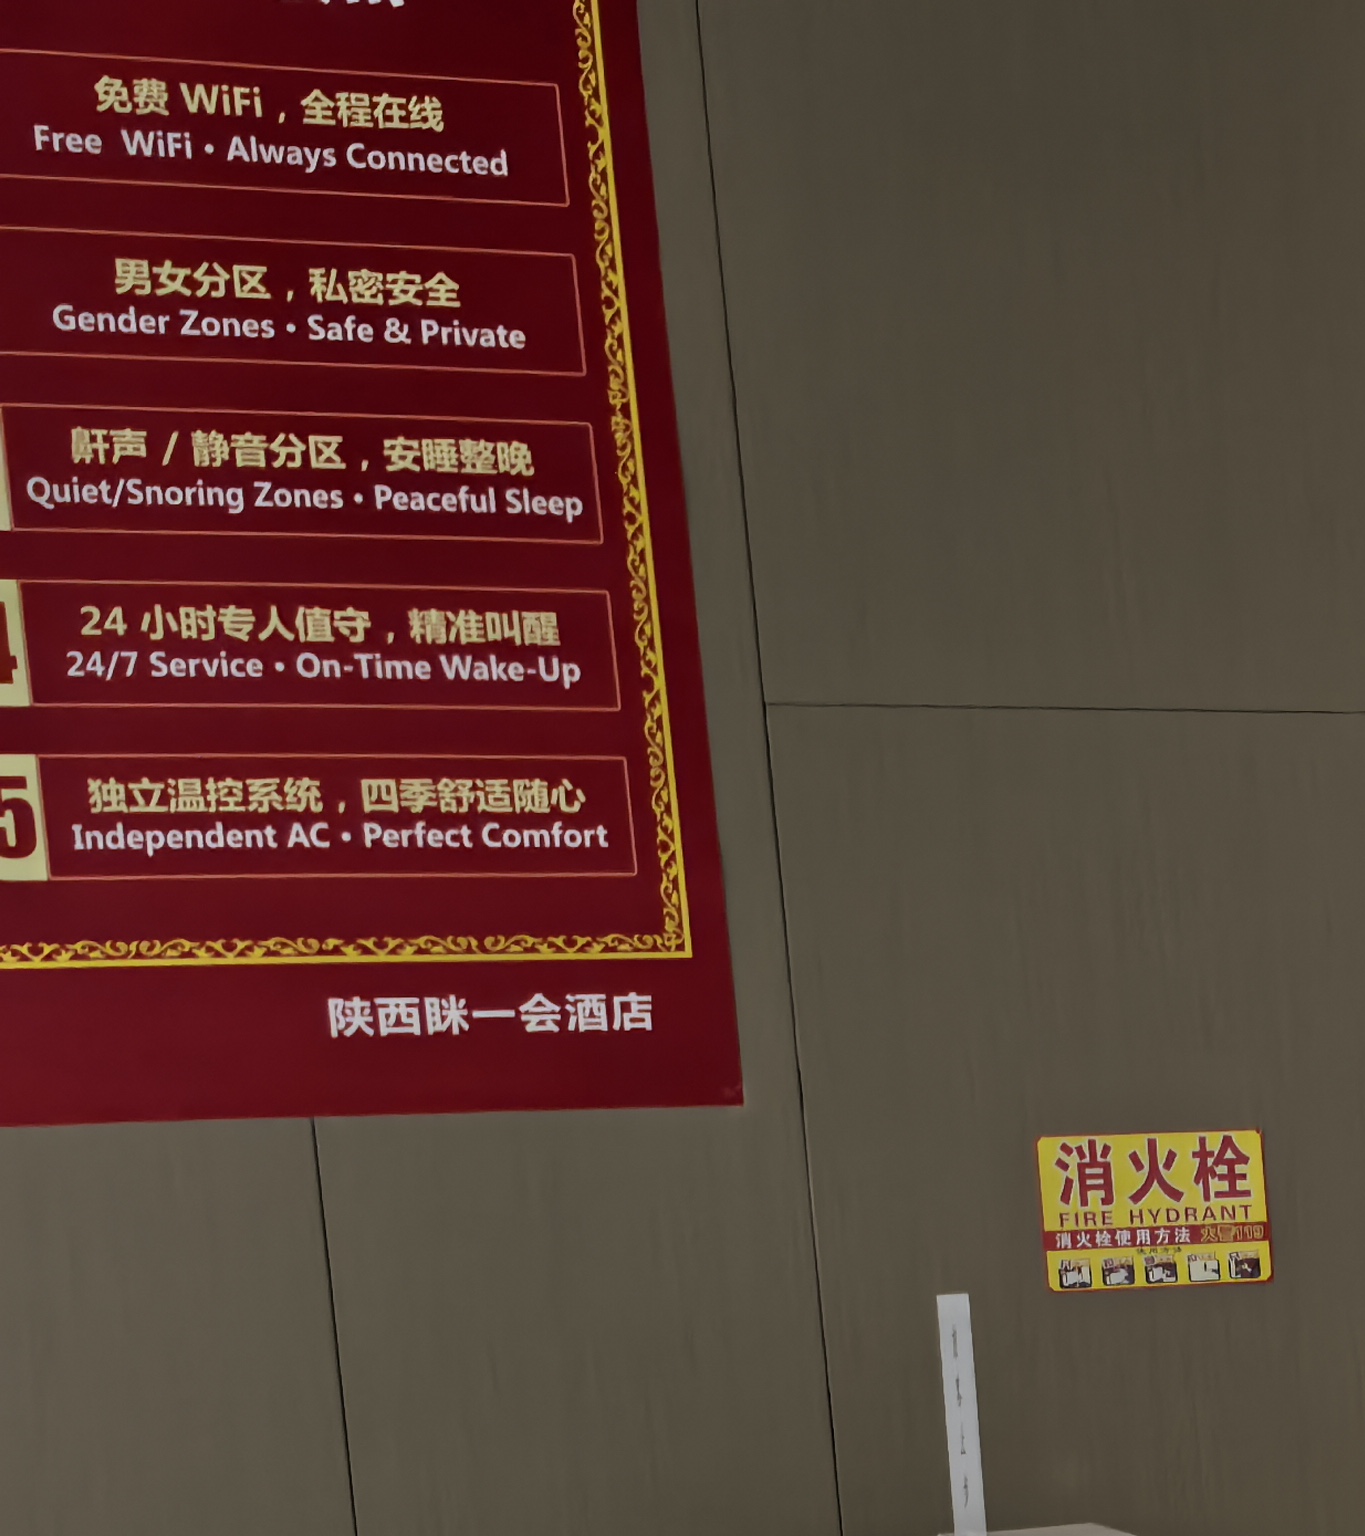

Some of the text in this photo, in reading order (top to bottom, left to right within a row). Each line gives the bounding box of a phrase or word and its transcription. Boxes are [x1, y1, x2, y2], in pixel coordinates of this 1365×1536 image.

[94, 75, 169, 117] 免费
[34, 125, 508, 177] Free WiFi Always Connected
[114, 258, 461, 308] 男女分区，私密安全
[52, 305, 526, 349] Gender Zones Safe & Private
[192, 431, 534, 478] 静音分区，安睡整晚
[27, 477, 583, 522] Quiet/Snoring Zones Peaceful Sleep
[80, 605, 561, 646] 24 小时专人值守，精准叫醒
[66, 651, 581, 689] 24/7 Service On-Time Wake-Up
[0, 776, 37, 858] 5
[88, 777, 585, 815] 独立温控系统，四季舒适随心
[72, 823, 609, 856] Independent AC Perfect Comfort
[327, 993, 653, 1037] 陕西眯一会酒店
[1055, 1134, 1252, 1208] 消火栓
[1055, 1226, 1191, 1249] 消火栓使用方法
[1058, 1204, 1253, 1228] FIRE HYDRANT
